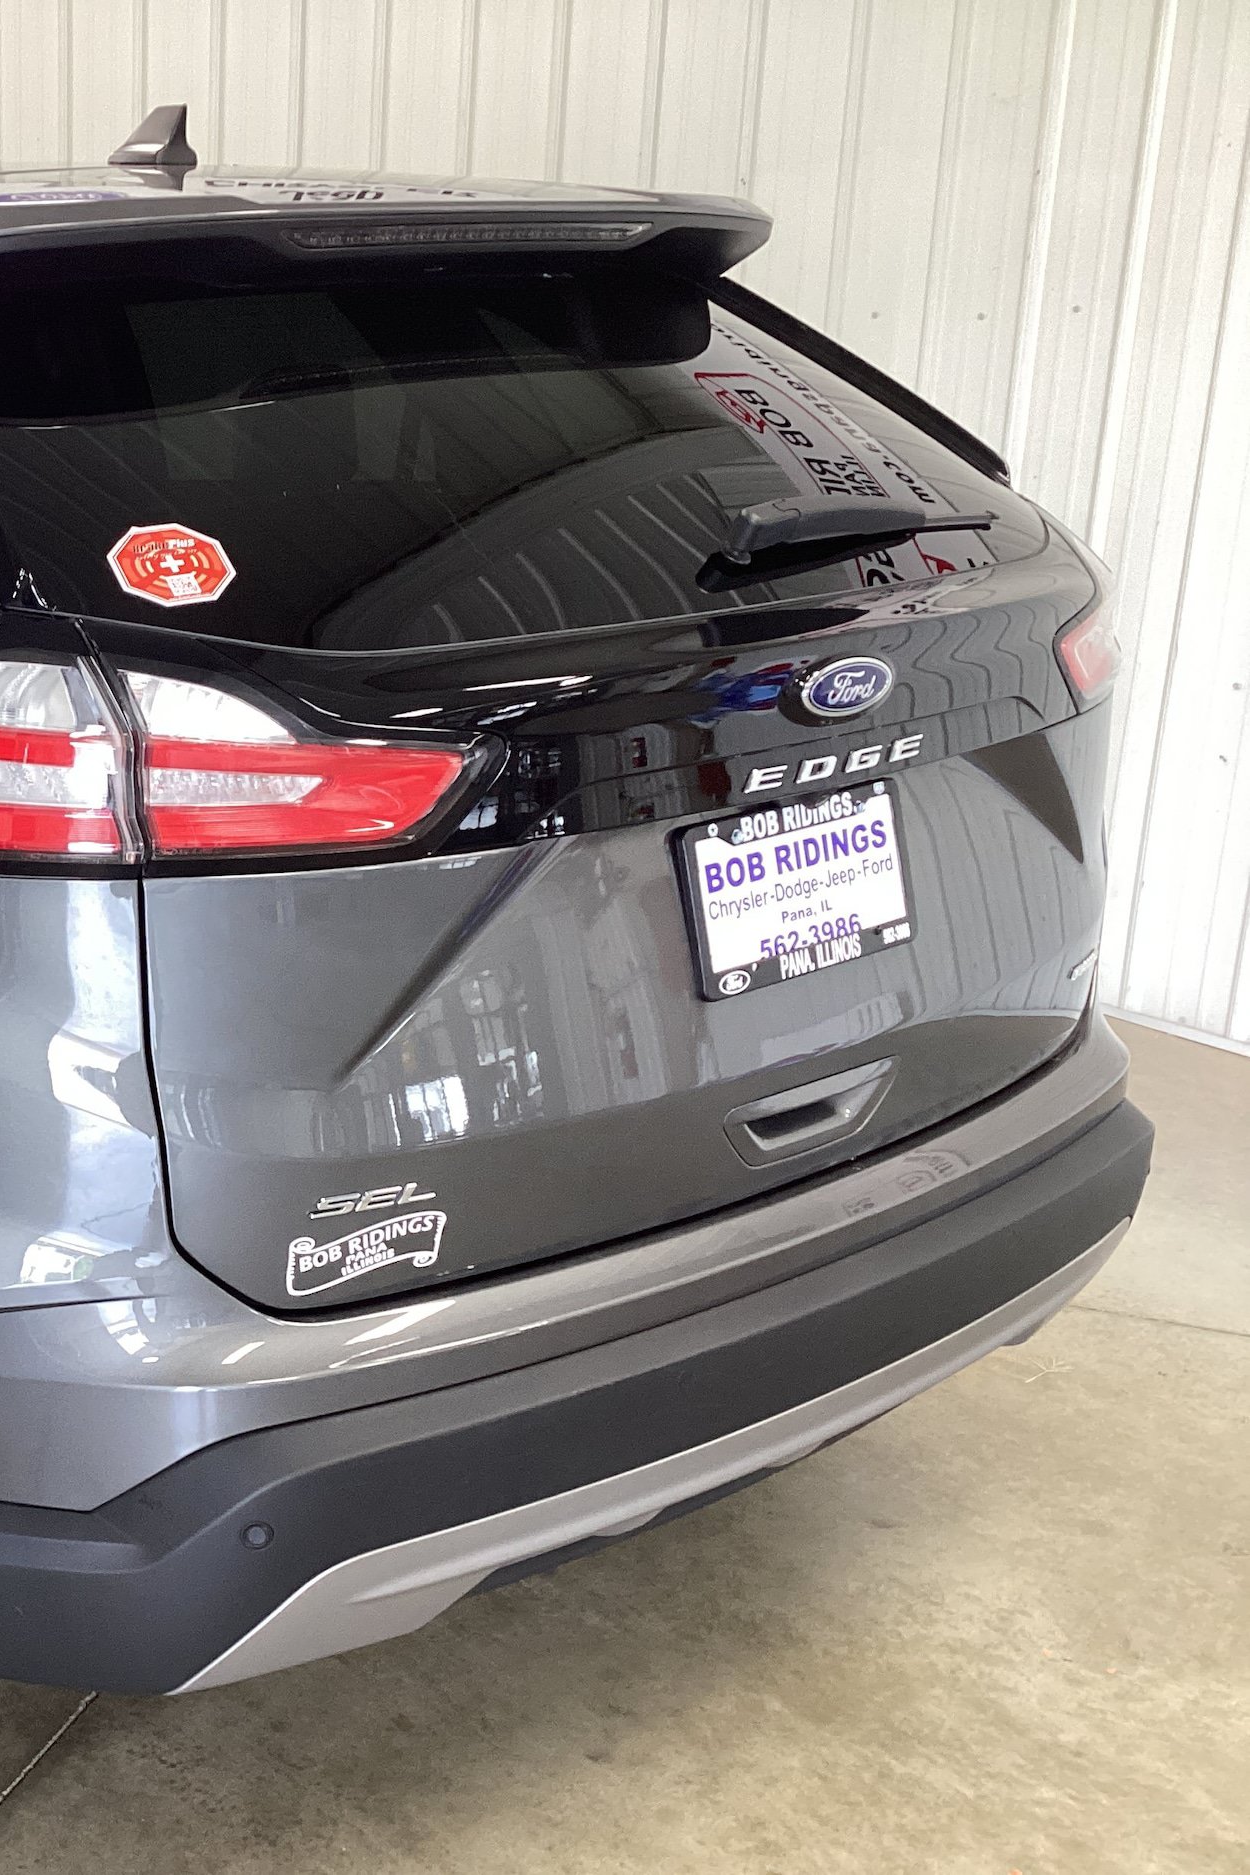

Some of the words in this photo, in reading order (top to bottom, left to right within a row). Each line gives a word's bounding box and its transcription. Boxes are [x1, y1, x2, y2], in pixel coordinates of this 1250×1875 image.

[827, 670, 877, 705] Ford
[743, 733, 924, 793] EDGE
[739, 810, 779, 842] BOB
[704, 851, 766, 894] BOB
[774, 820, 887, 876] RIDINGS
[781, 909, 818, 924] Pana,
[820, 899, 833, 912] IL
[760, 913, 861, 961] 562-3986
[816, 934, 862, 968] ILLINOIS
[307, 1182, 437, 1220] SEL
[300, 1245, 343, 1272] BOB
[348, 1215, 435, 1254] RIDINGS
